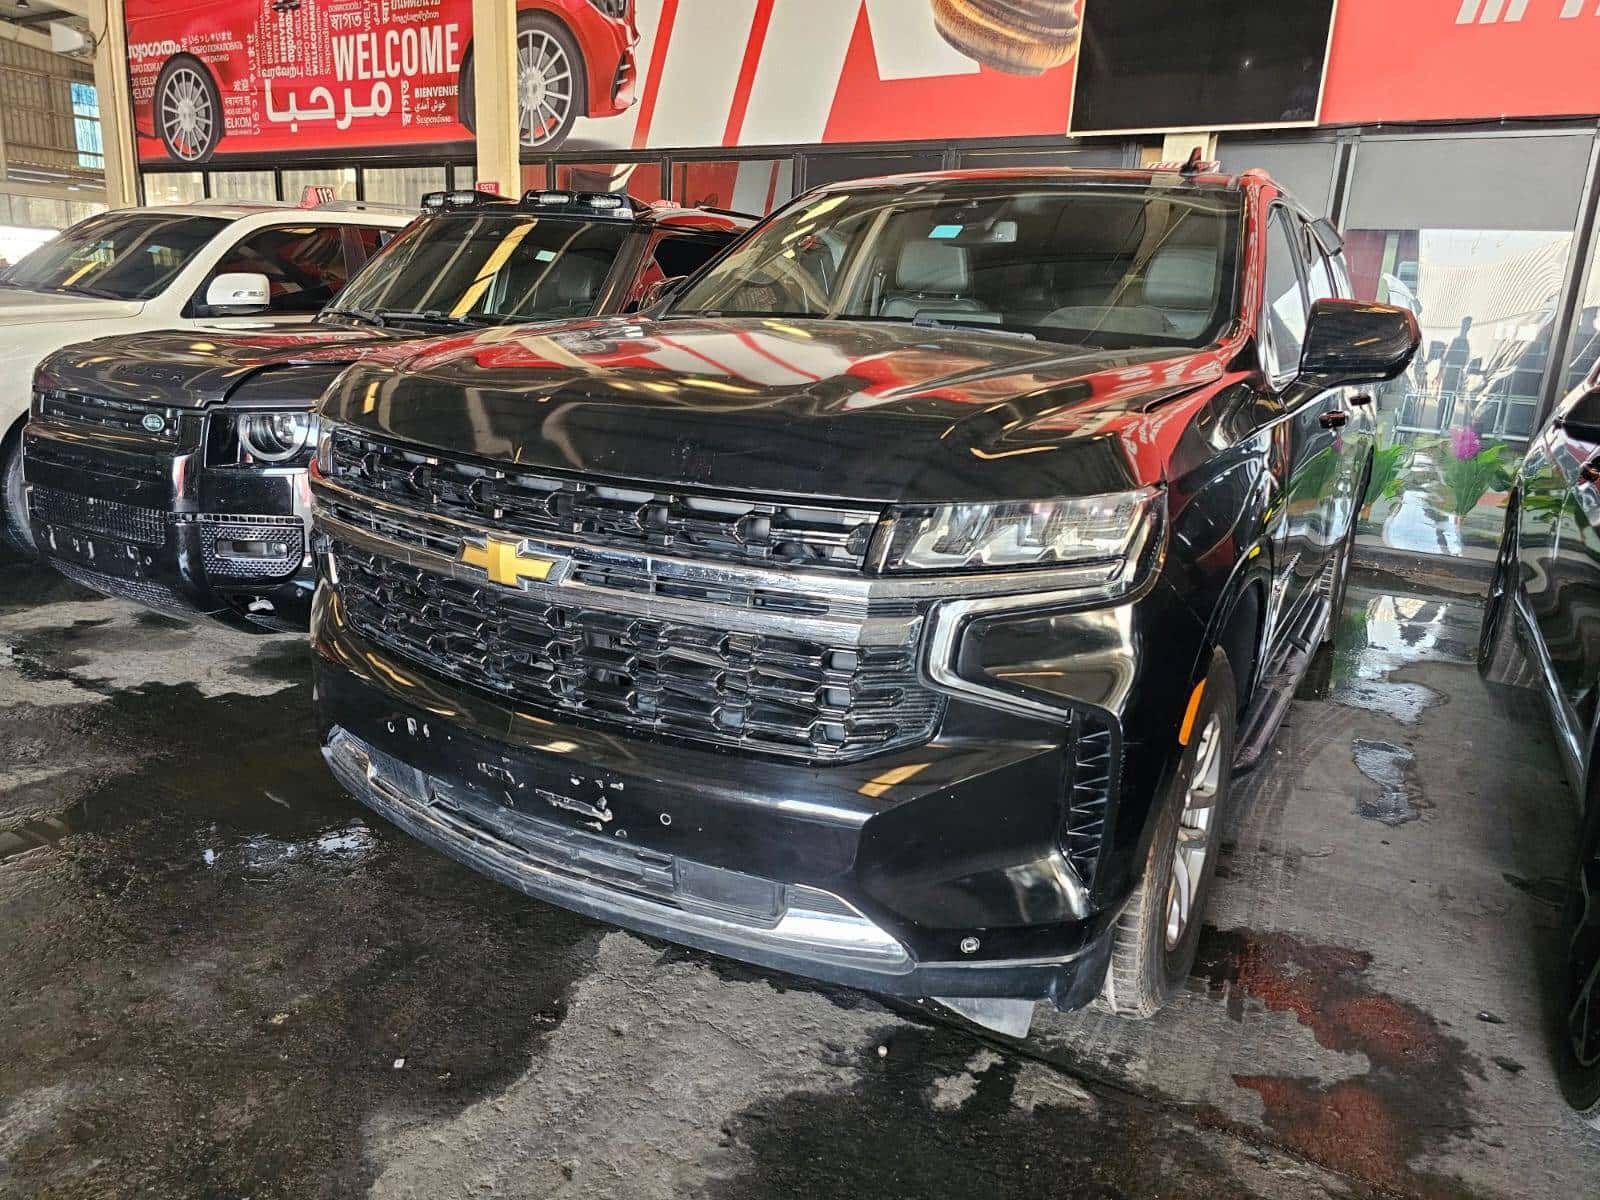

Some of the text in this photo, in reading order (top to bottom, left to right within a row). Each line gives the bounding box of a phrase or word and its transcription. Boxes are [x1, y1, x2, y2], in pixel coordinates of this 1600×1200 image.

[331, 23, 460, 81] WELCOME
[263, 79, 393, 133] مرحبا
[414, 85, 459, 99] BIENVENUE
